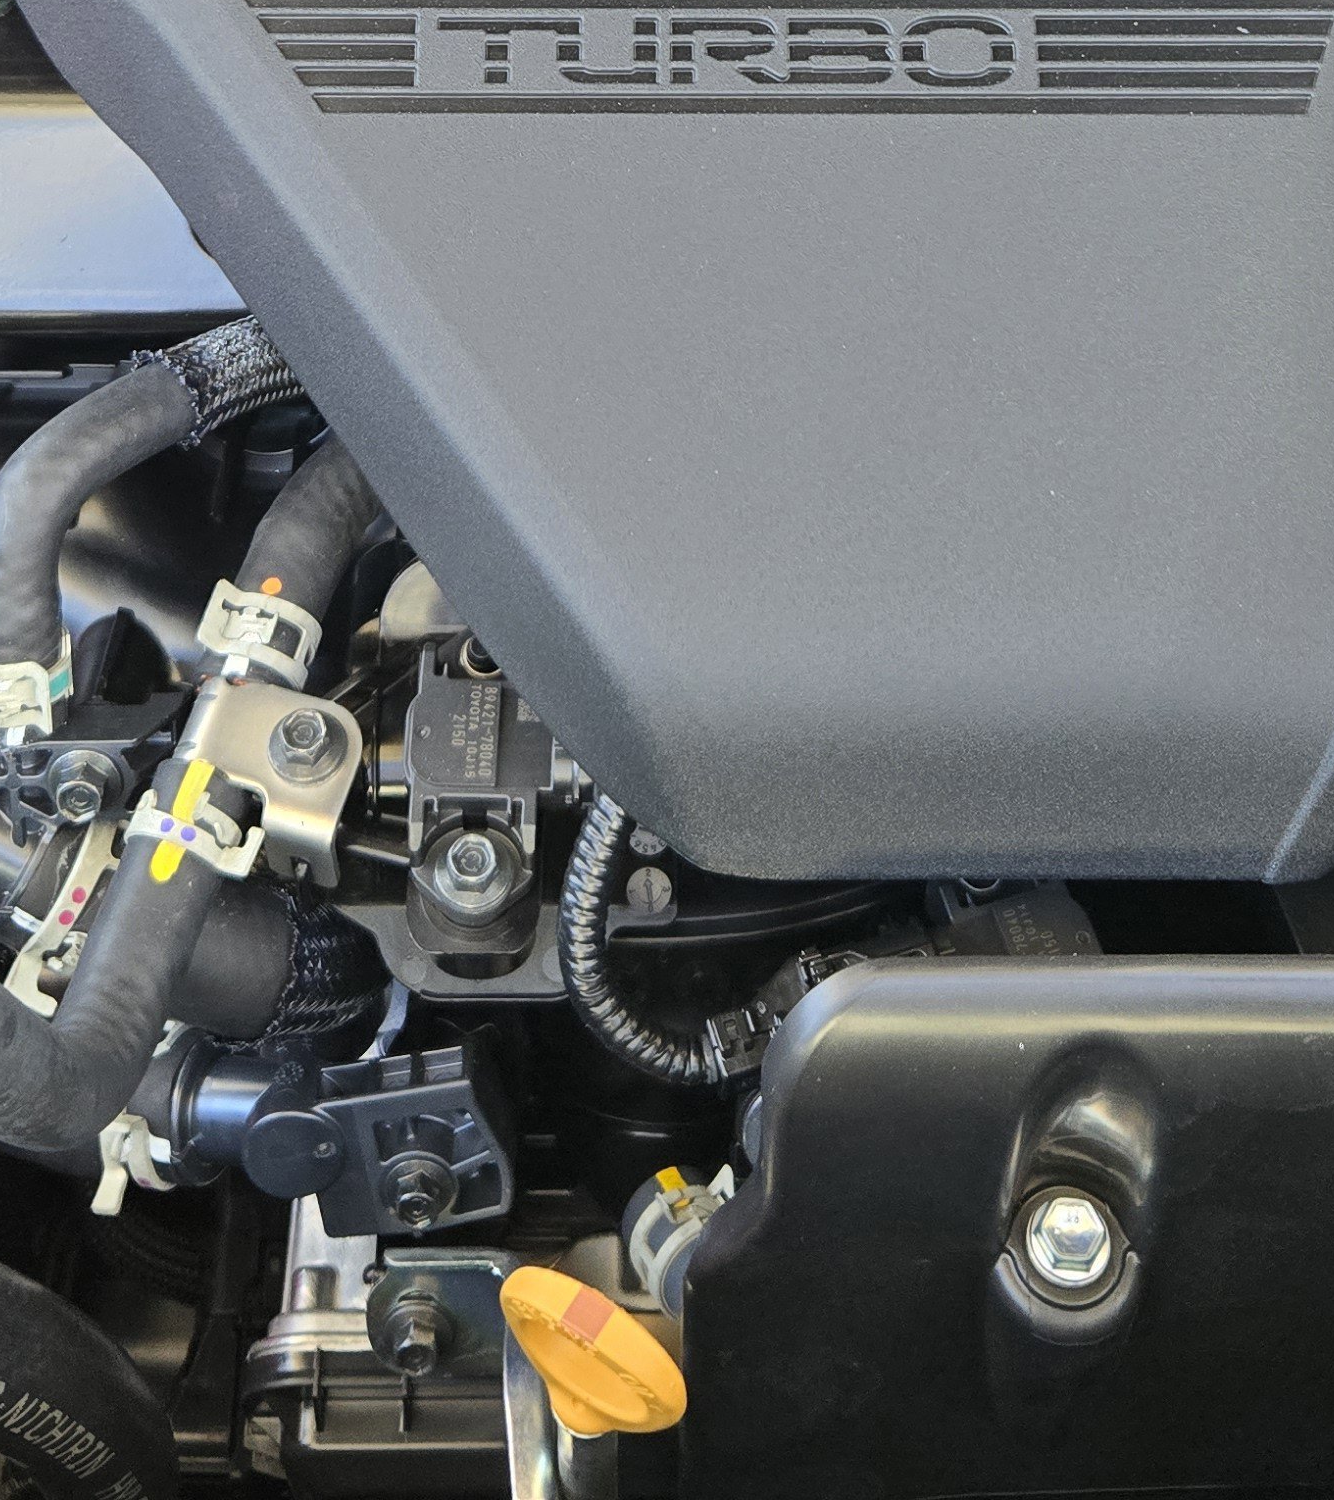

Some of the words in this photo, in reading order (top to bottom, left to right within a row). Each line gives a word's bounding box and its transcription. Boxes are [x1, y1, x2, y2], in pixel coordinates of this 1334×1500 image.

[436, 14, 1018, 87] TURBO
[452, 714, 467, 746] 2150
[468, 684, 483, 731] TOYOTA
[478, 685, 499, 777] 89421-78040
